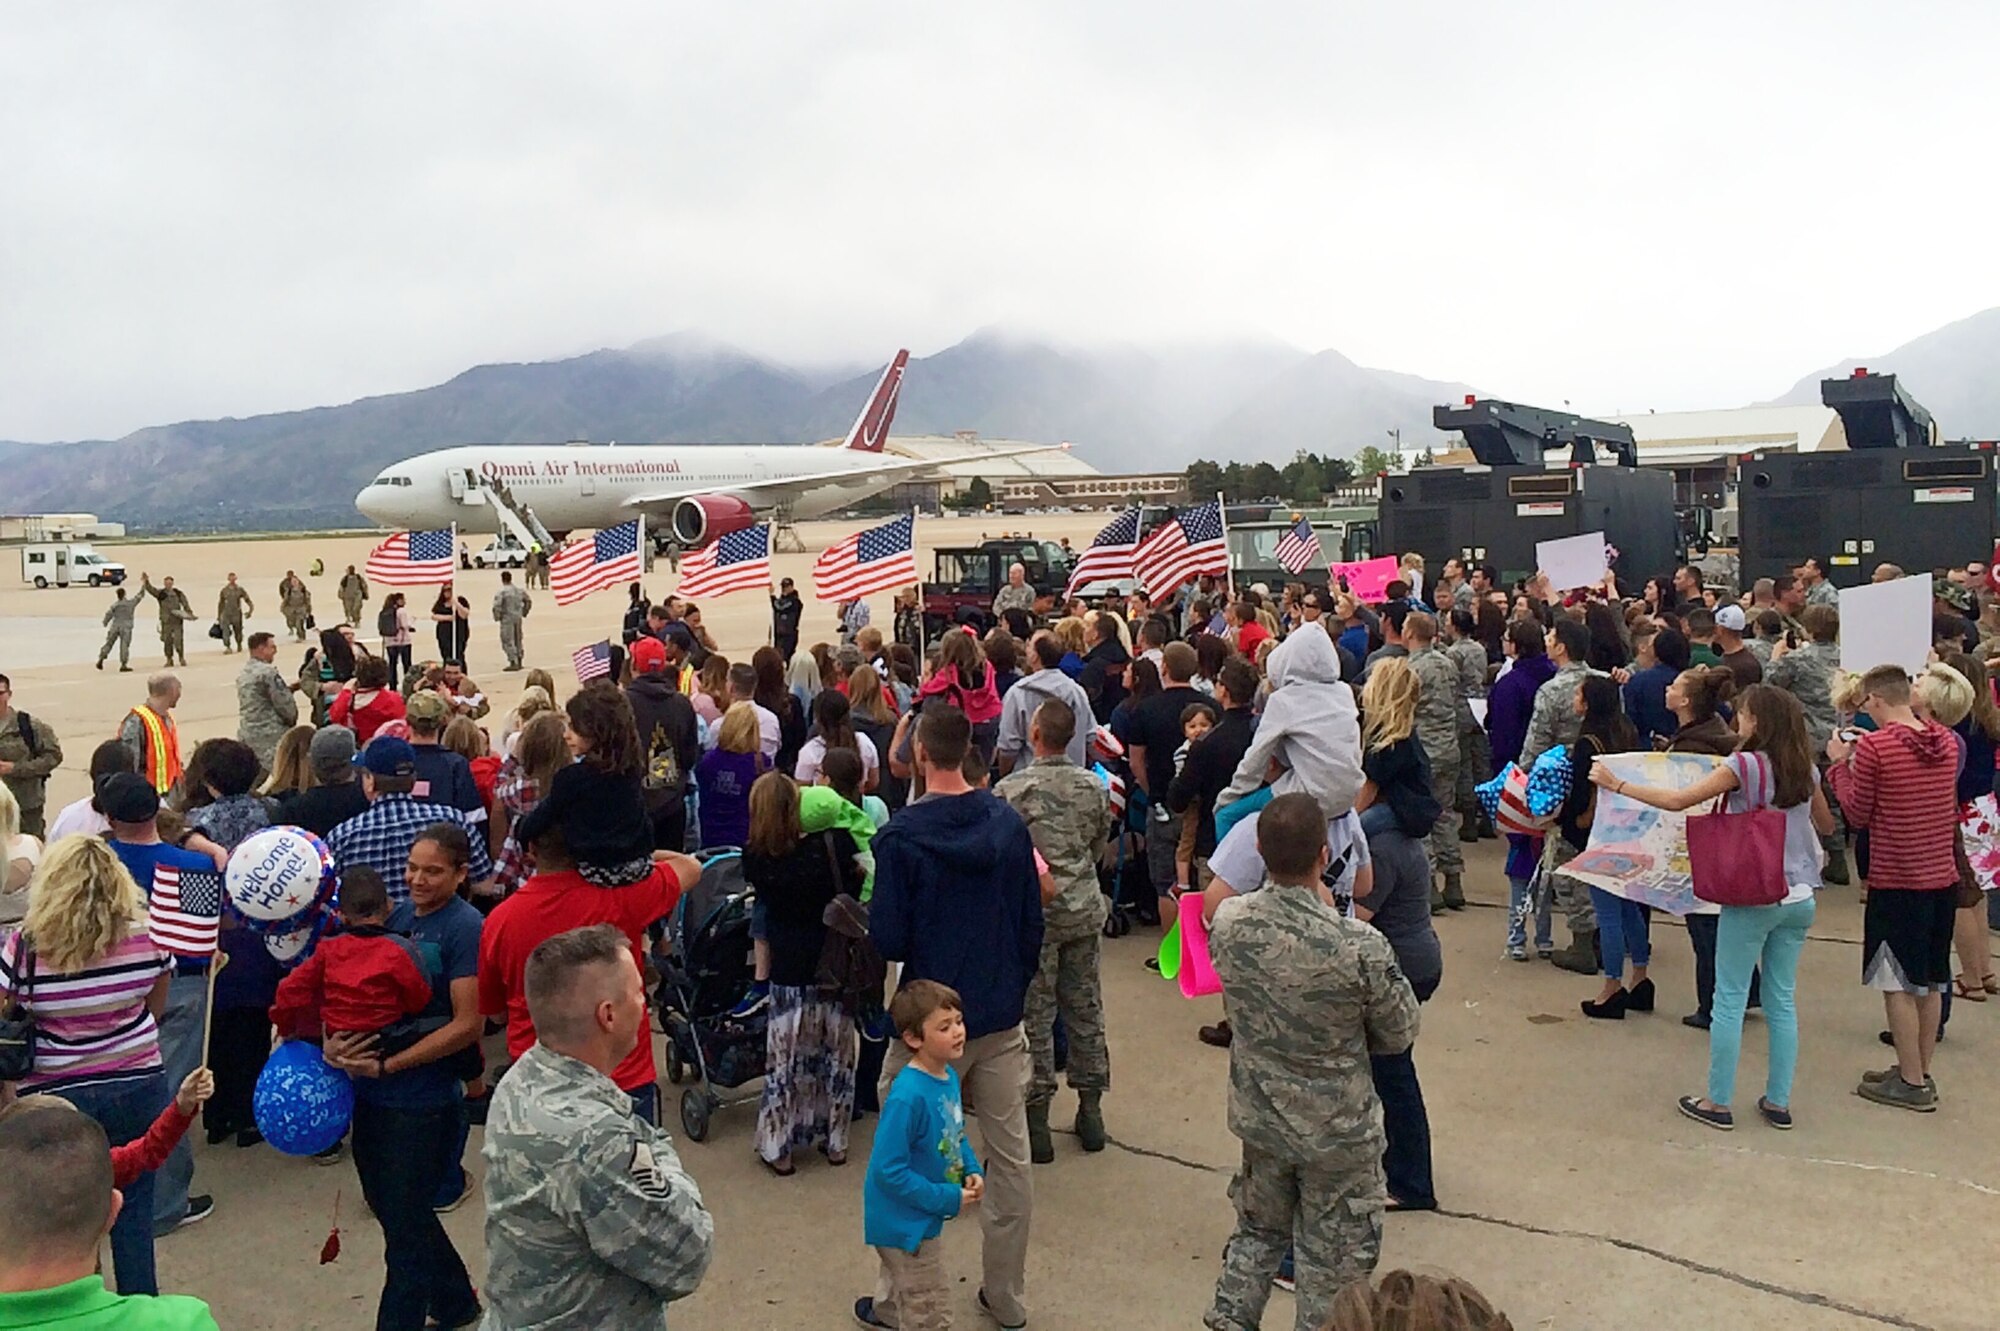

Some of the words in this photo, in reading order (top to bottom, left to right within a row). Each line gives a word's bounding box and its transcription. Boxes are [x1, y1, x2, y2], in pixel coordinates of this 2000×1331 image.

[482, 461, 536, 476] Omni
[541, 460, 569, 476] Air
[573, 459, 681, 475] International
[258, 853, 306, 910] Home!
